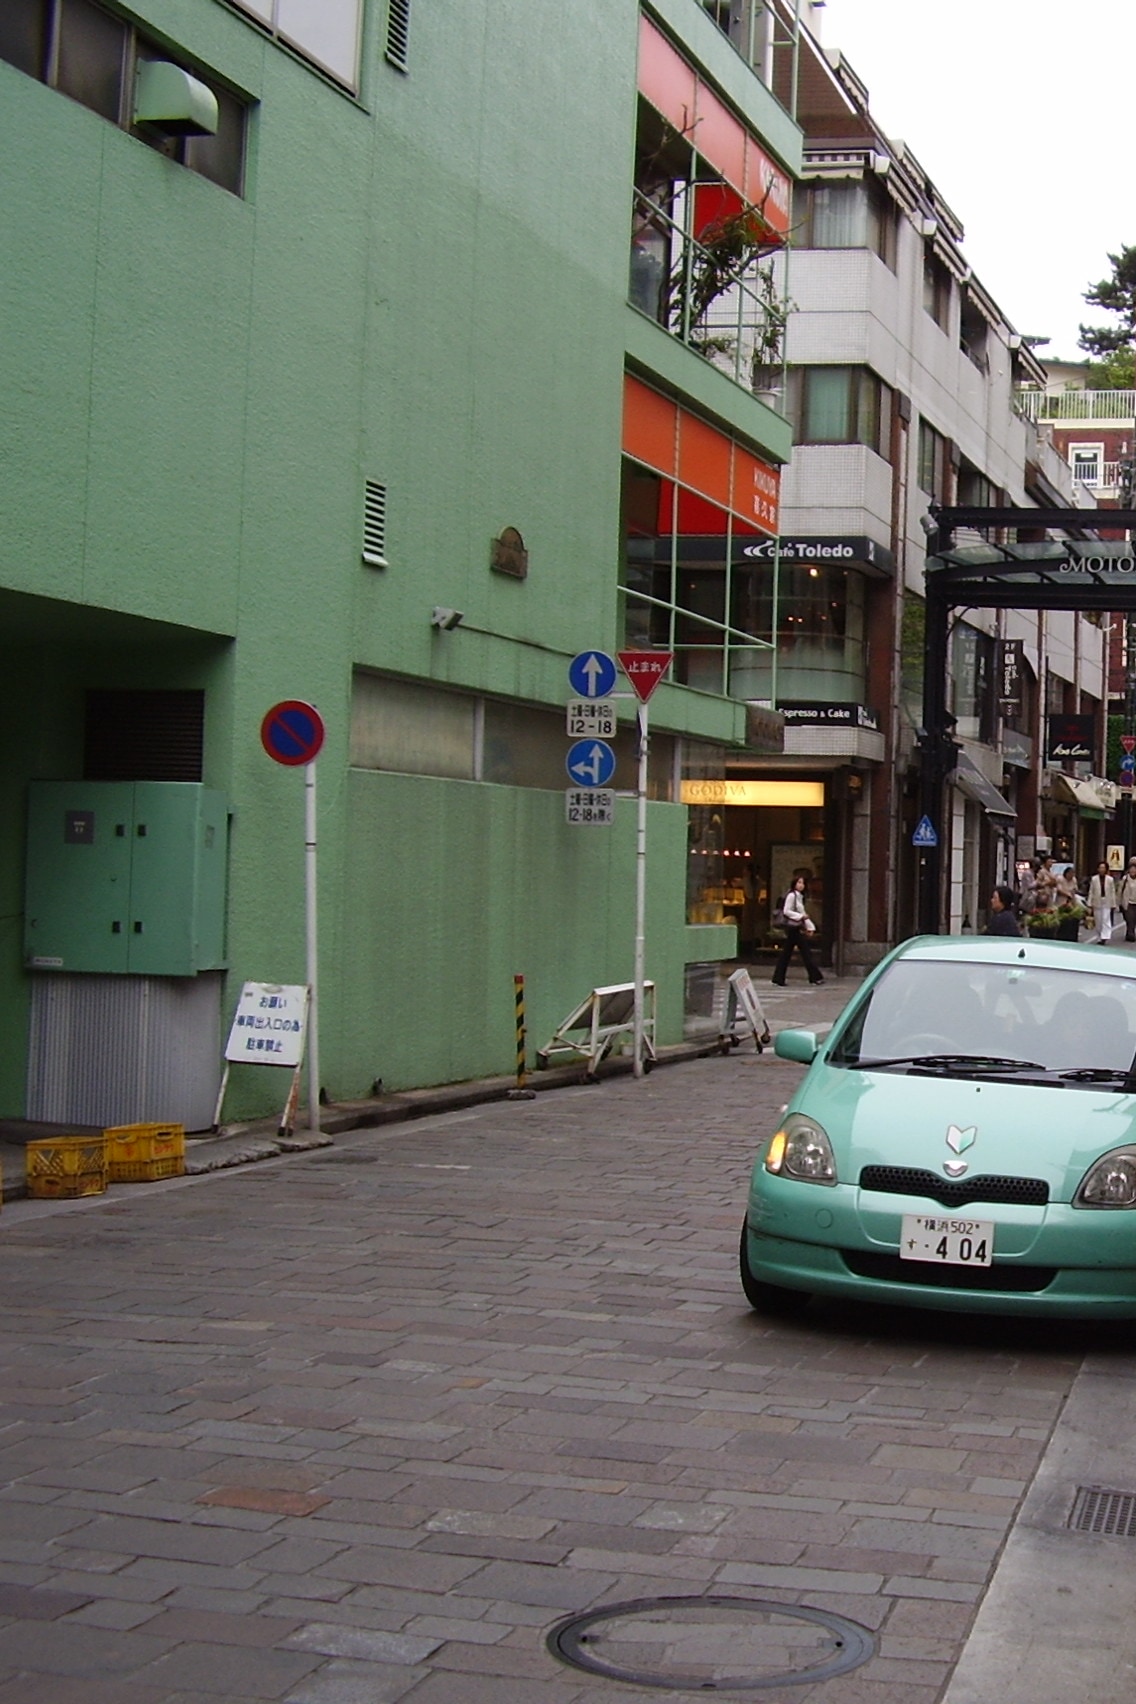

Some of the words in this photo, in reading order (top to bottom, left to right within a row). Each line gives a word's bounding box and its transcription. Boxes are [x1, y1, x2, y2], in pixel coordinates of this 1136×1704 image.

[795, 544, 853, 557] Toledo
[628, 661, 662, 673] 止まれ
[828, 708, 850, 718] Cake
[689, 784, 747, 796] GODIVA
[260, 996, 287, 1008] お願い
[246, 1037, 283, 1053] 駐車禁止
